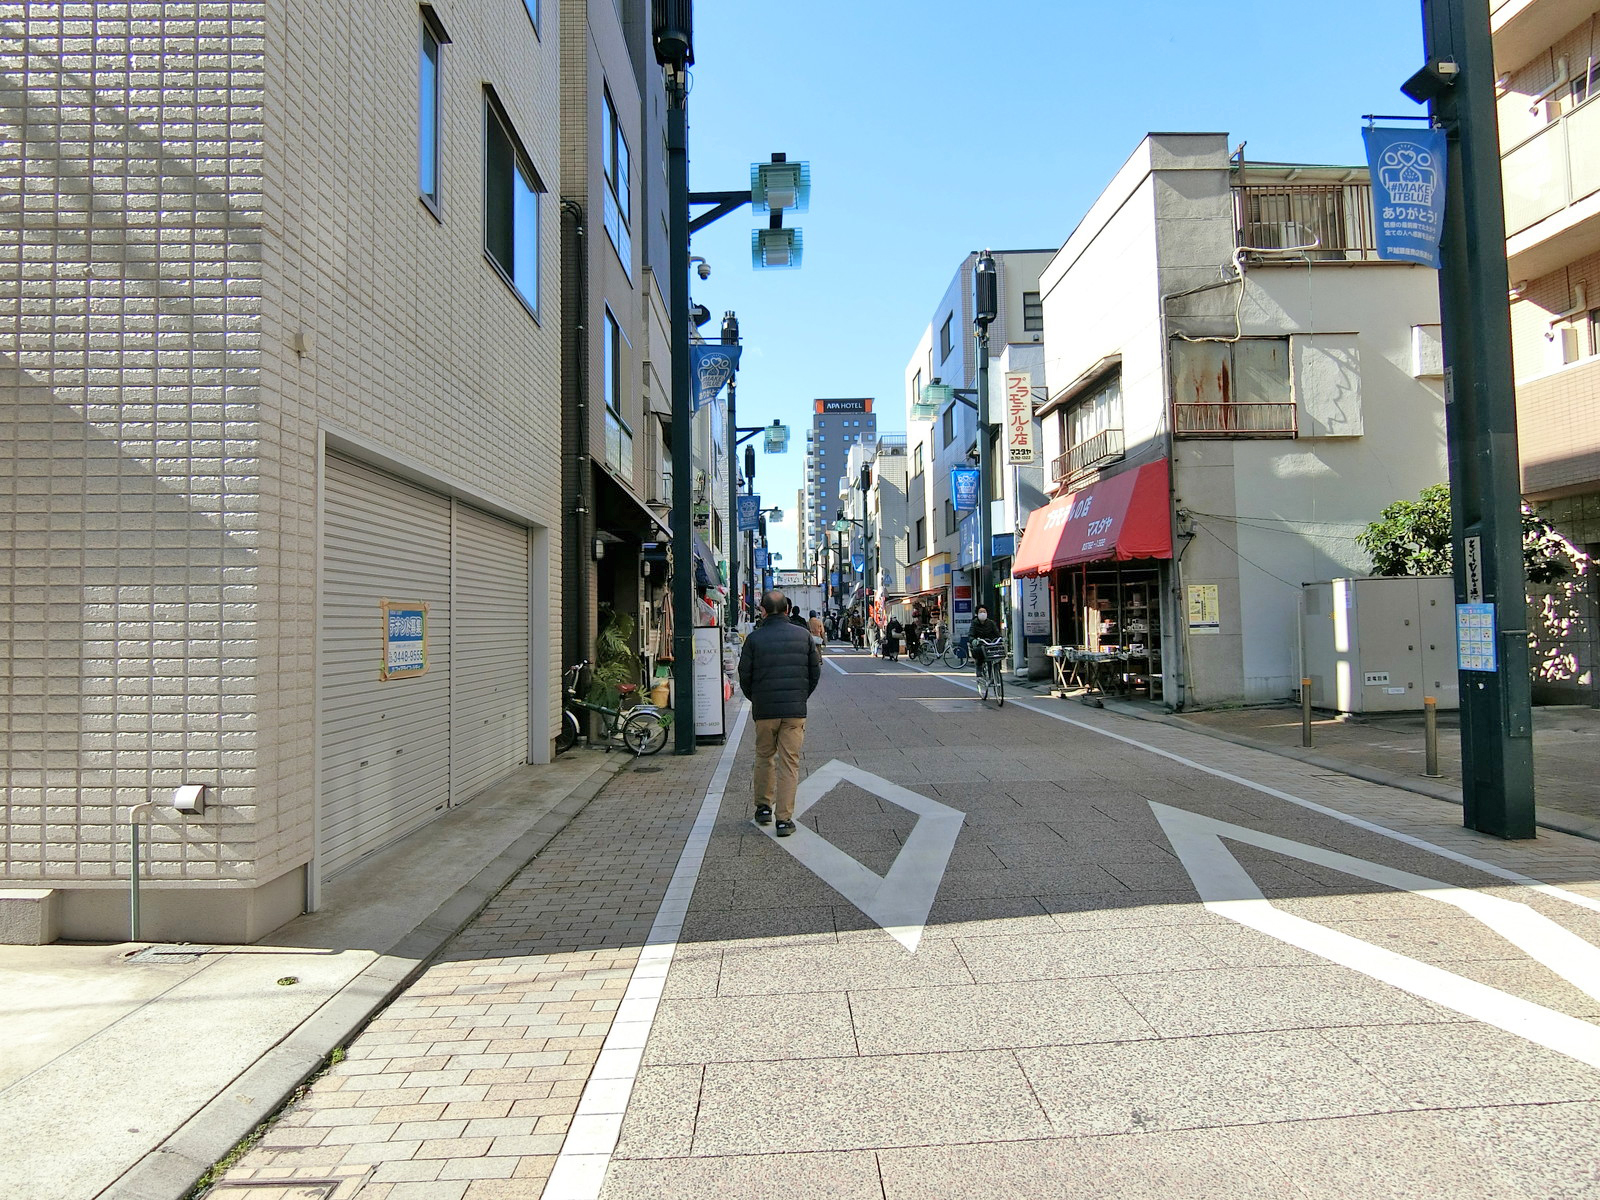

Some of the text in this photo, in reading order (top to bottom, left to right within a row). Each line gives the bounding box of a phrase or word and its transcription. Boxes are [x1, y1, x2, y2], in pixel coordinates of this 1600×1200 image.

[1390, 182, 1430, 195] #MAKE
[1392, 192, 1430, 204] ITBLUE
[1008, 376, 1030, 446] プラモデルの店
[1087, 516, 1113, 537] マスダヤ
[389, 615, 423, 637] テナント募集
